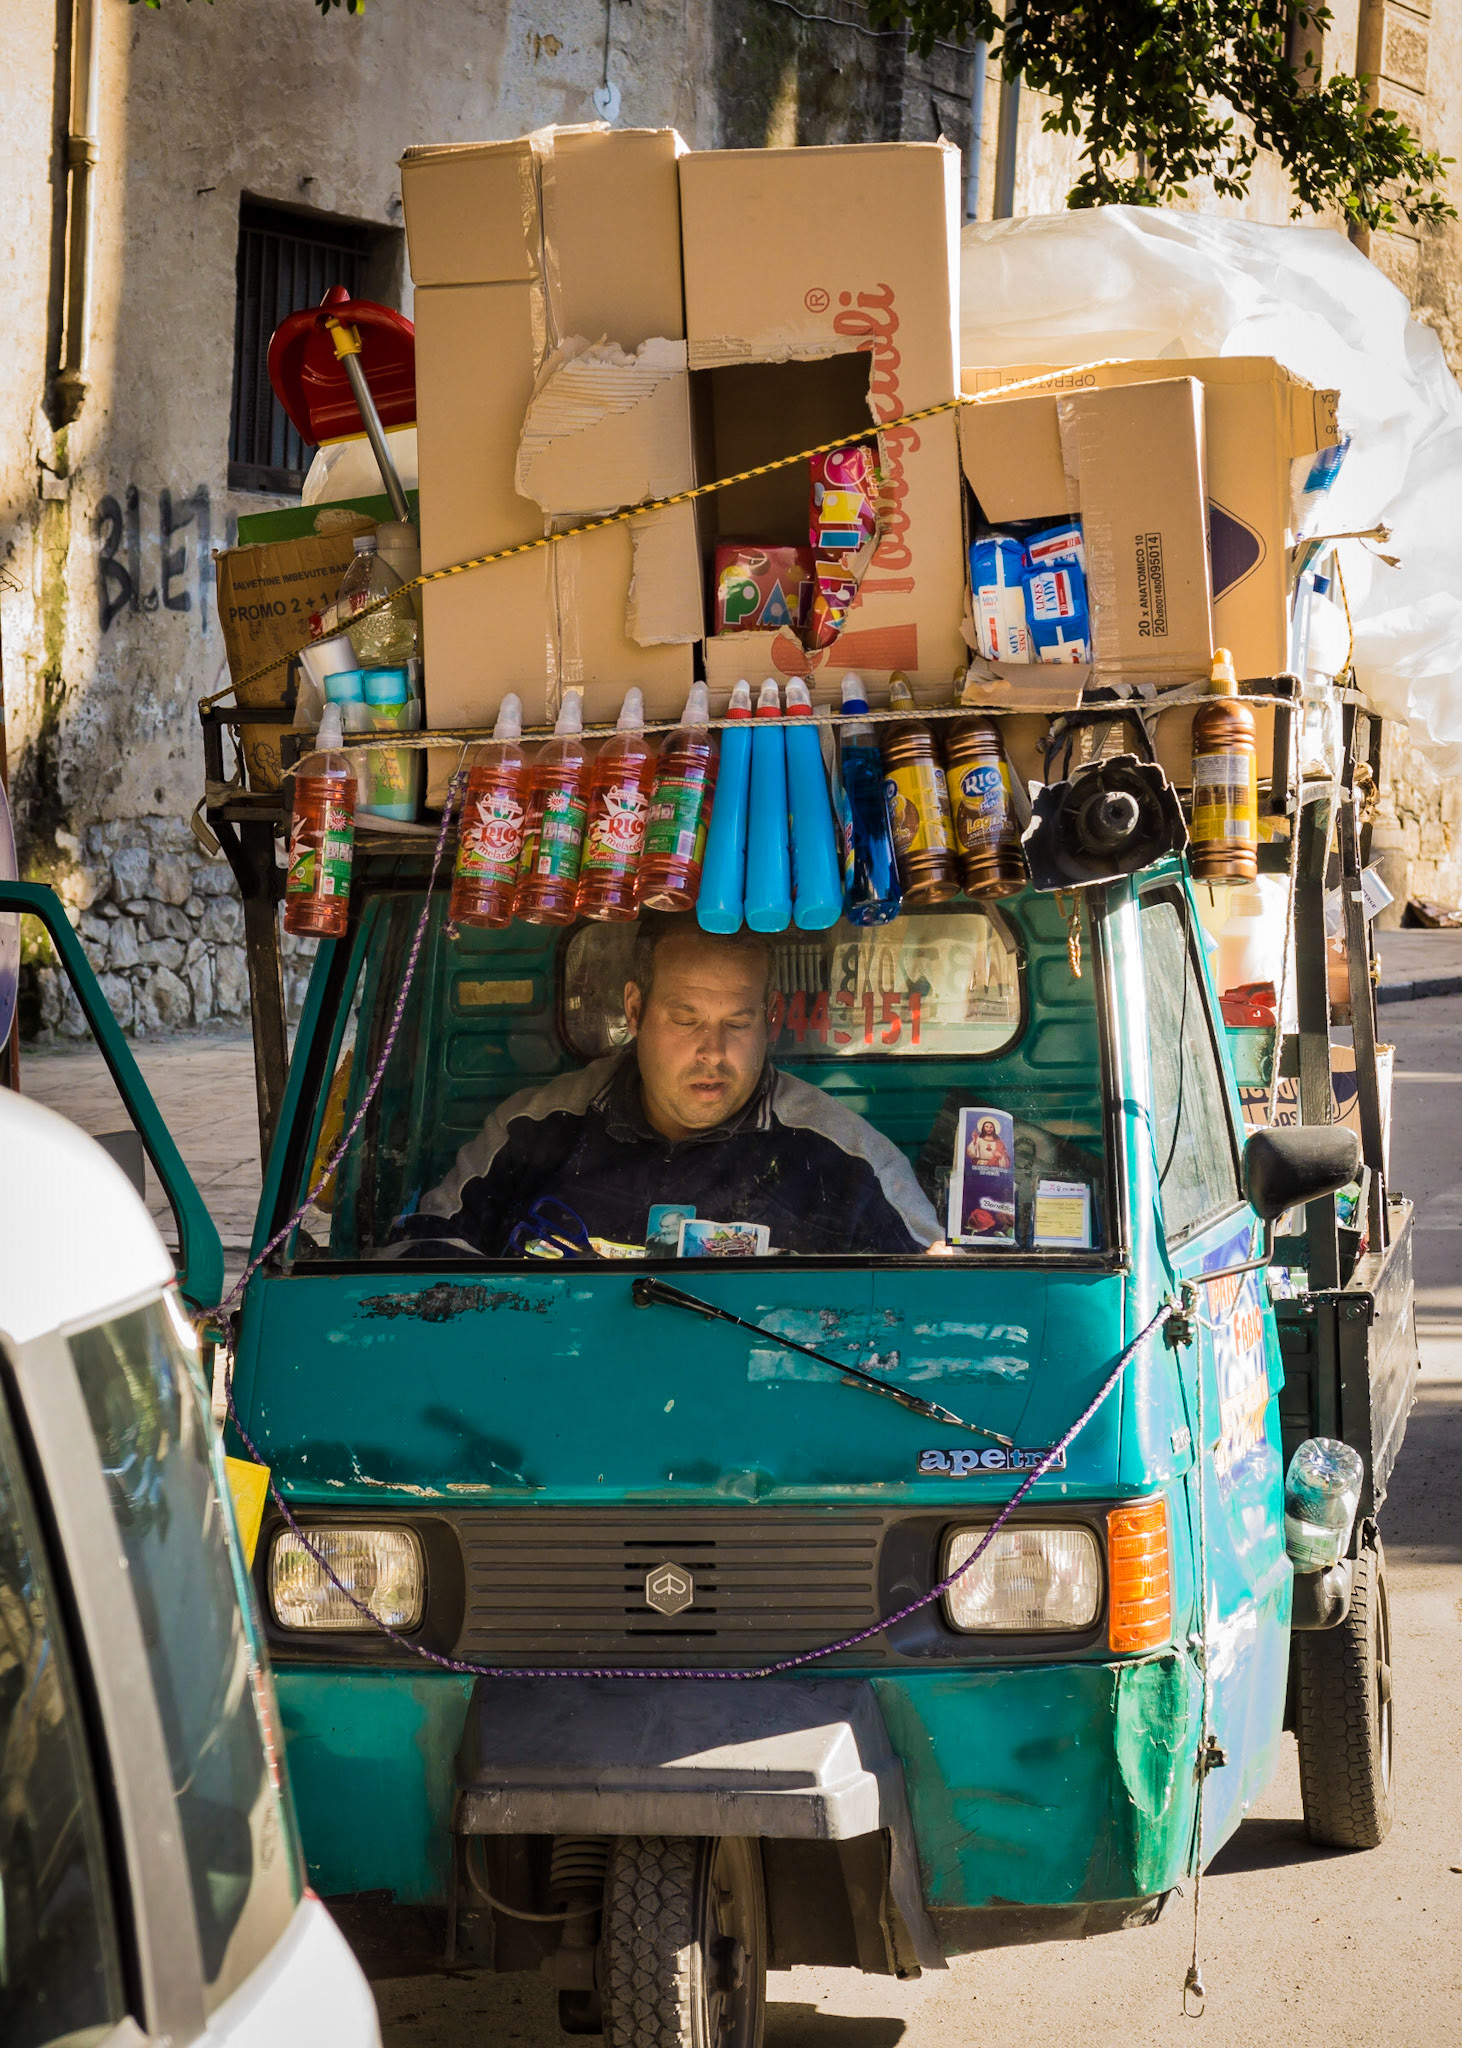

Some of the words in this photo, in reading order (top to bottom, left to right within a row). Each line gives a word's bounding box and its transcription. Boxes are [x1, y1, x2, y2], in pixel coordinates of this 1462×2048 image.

[1135, 535, 1144, 546] 10
[283, 567, 328, 583] IMBEVUTE
[1136, 549, 1149, 609] ANATOMICO
[1034, 583, 1045, 610] LINES
[1043, 580, 1058, 612] LADY
[229, 600, 286, 623] PROMO
[291, 598, 302, 614] 2
[1138, 620, 1151, 637] 20
[965, 770, 1001, 794] RIO
[480, 826, 518, 848] RIO
[608, 818, 645, 840] RIO
[1233, 1304, 1262, 1356] FABIO
